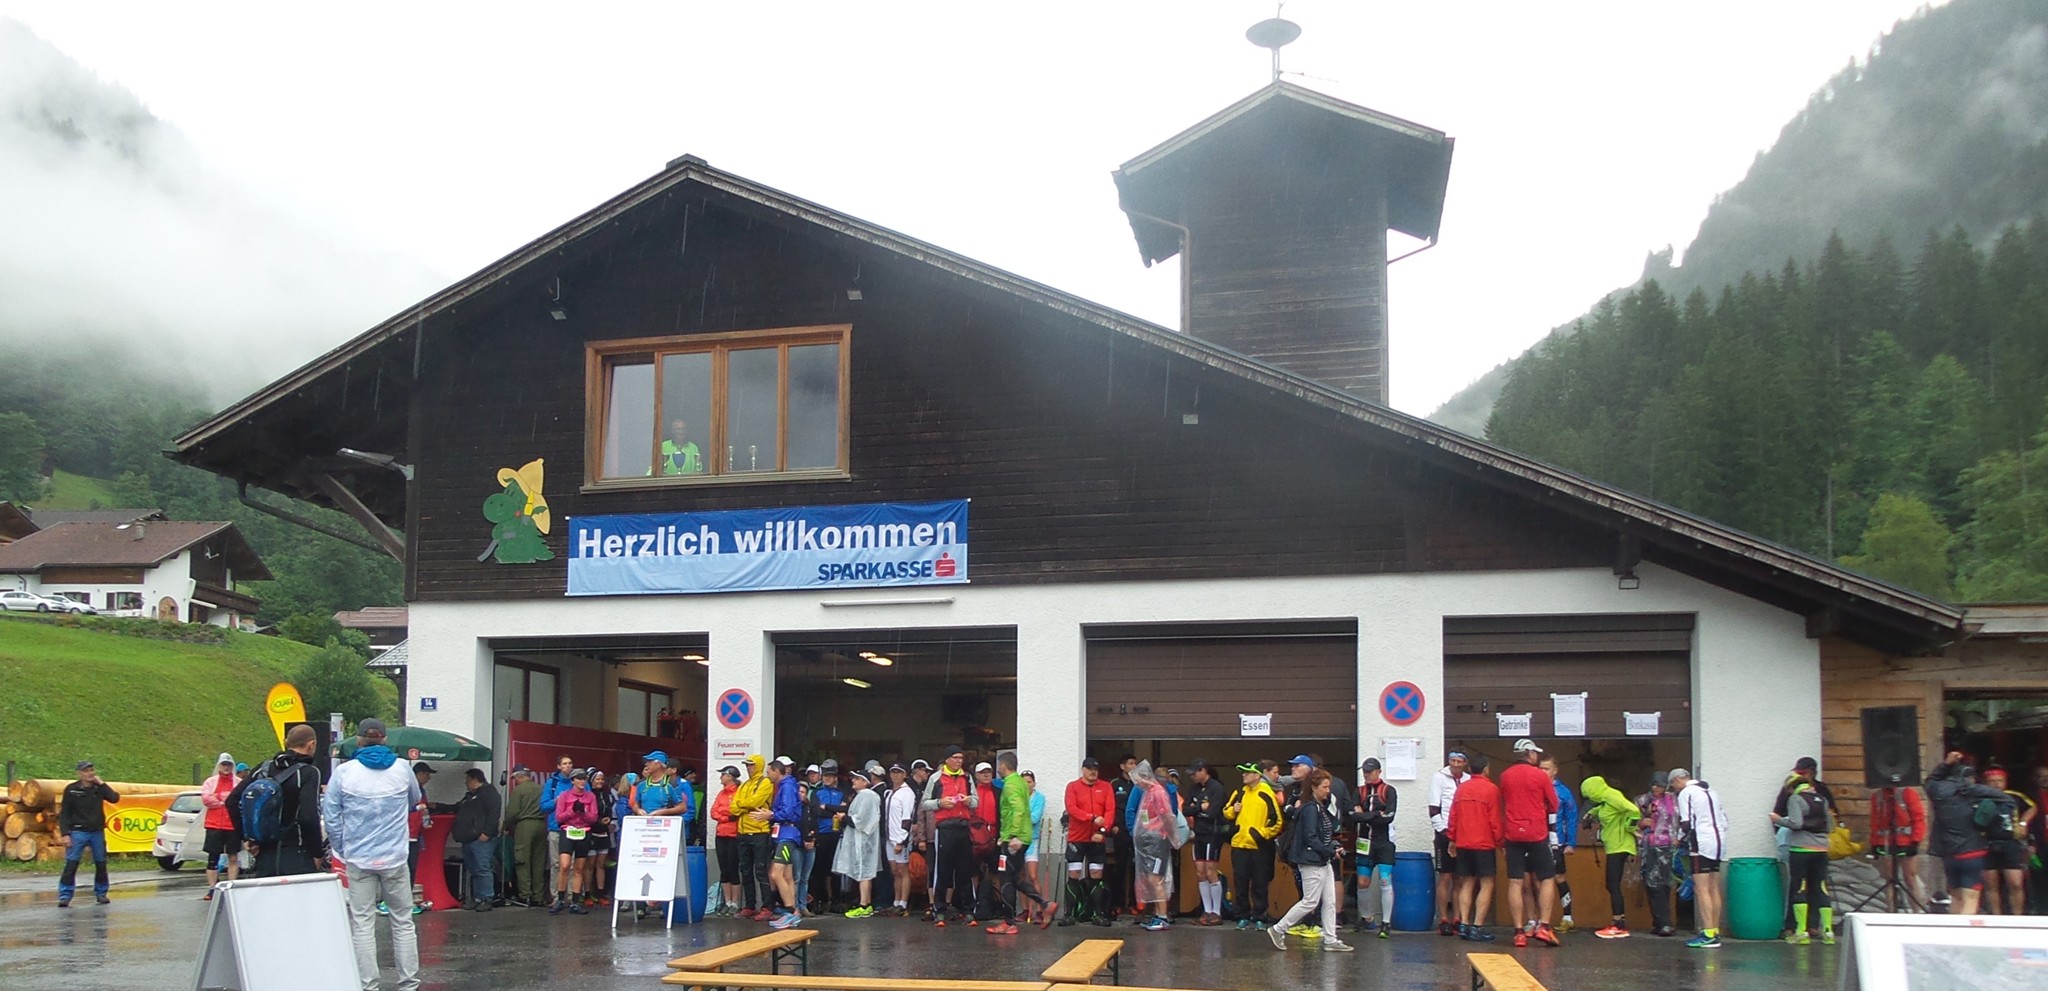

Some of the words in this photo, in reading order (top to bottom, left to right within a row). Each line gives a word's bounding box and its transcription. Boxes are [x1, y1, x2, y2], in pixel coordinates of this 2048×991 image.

[579, 524, 720, 559] Herzlich
[733, 519, 957, 553] willkommen
[817, 559, 933, 581] SPARKASSE
[1242, 720, 1268, 731] Essen
[1500, 719, 1528, 730] Getränke
[717, 741, 751, 749] Feuerwehr
